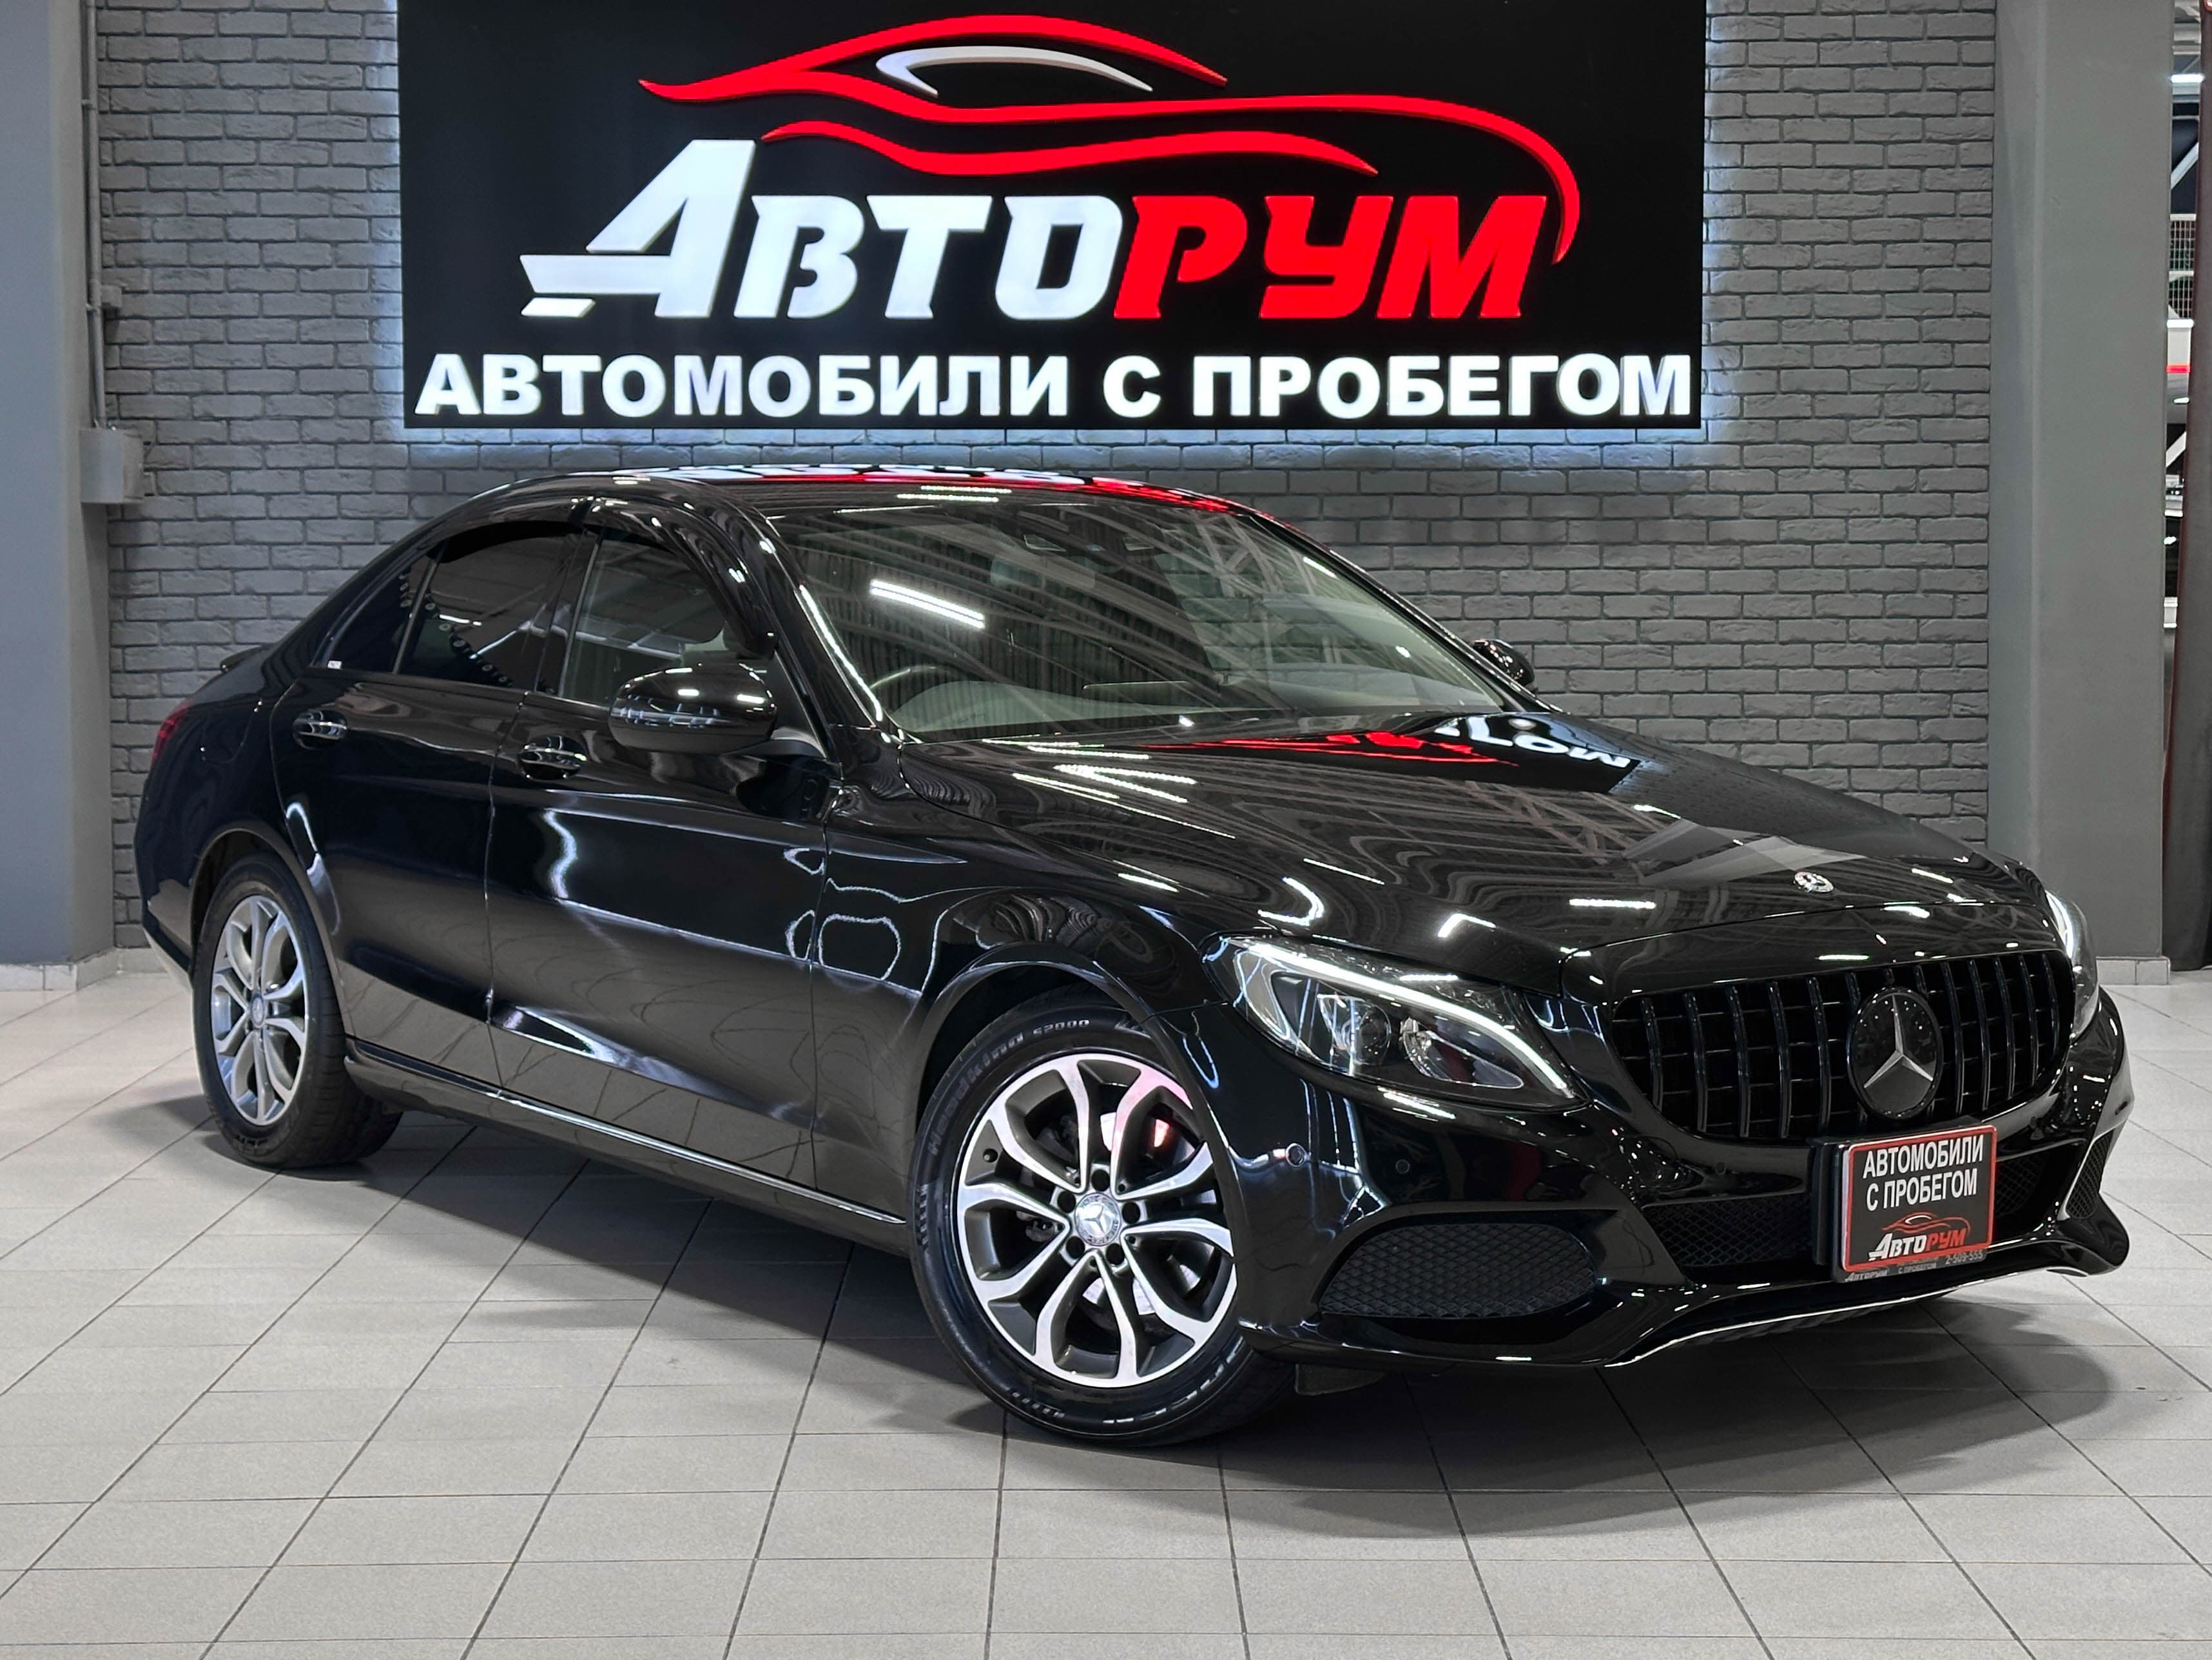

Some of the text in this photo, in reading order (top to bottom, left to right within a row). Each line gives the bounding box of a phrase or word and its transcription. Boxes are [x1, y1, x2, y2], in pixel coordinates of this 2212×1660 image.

[414, 353, 1691, 420] АВТОМОБИЛИ С ПРОБЕГОМ
[1863, 1134, 1984, 1179] АВТОМОБИЛИ
[1867, 1168, 1978, 1211] С ПРОБЕГОМ
